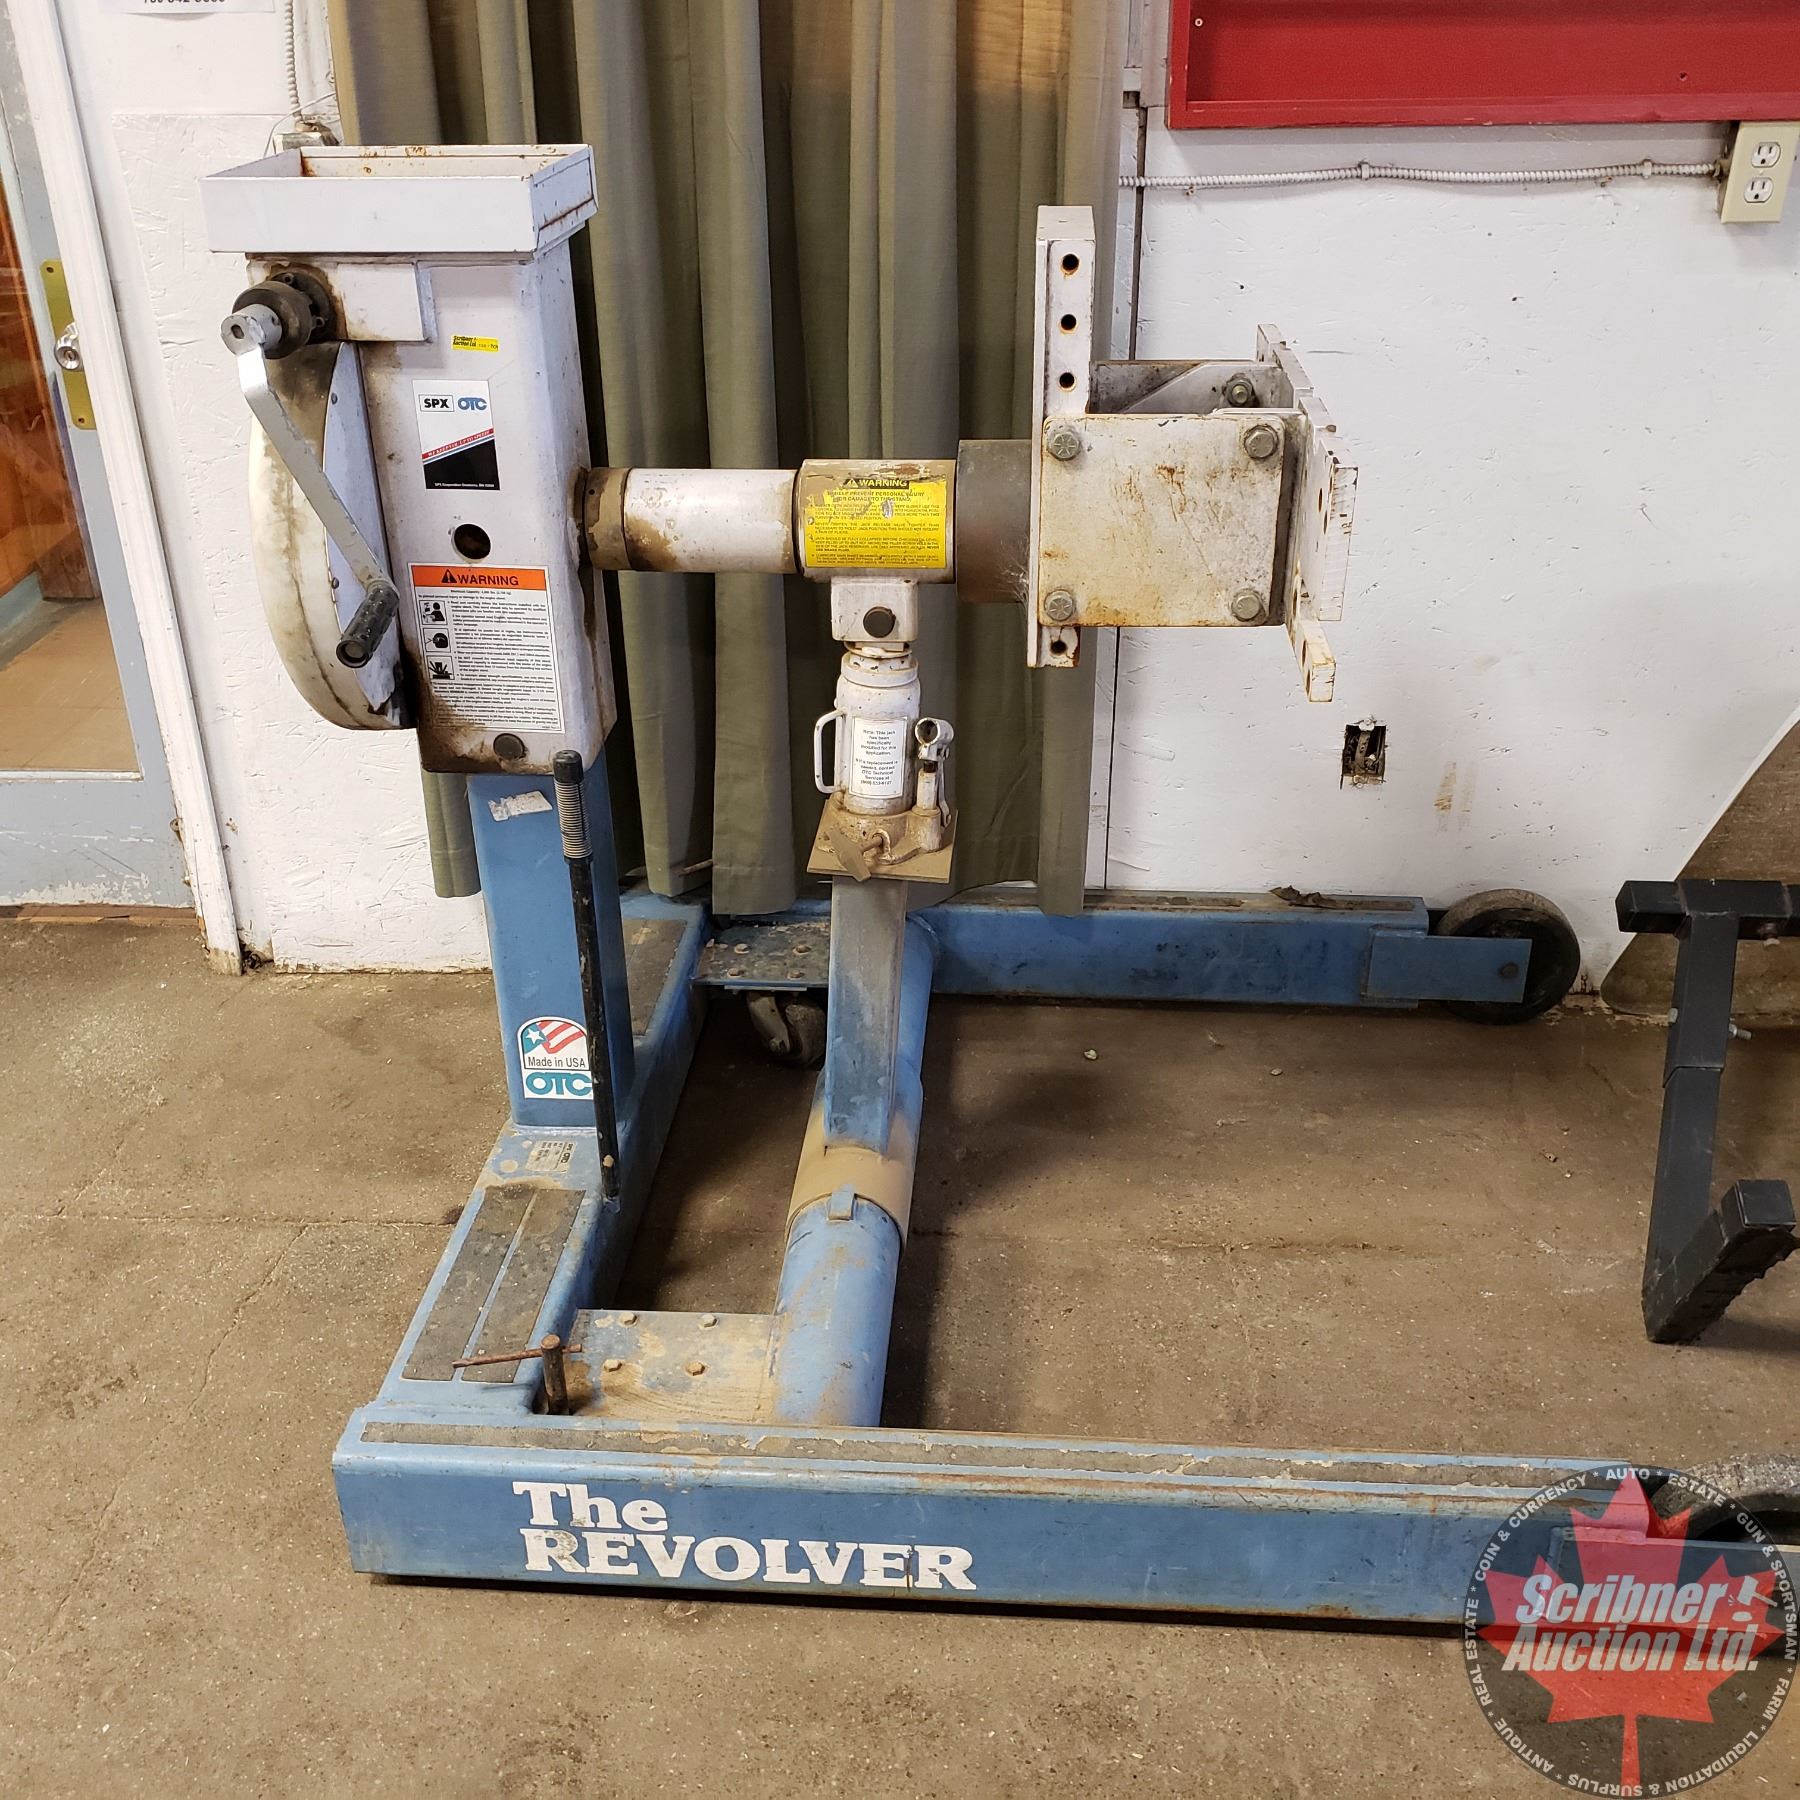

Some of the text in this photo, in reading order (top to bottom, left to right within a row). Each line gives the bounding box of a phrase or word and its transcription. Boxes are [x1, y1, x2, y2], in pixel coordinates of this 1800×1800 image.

[424, 398, 487, 410] SPX OTC
[858, 478, 908, 488] WARNING
[458, 574, 519, 586] WARNING
[528, 1056, 586, 1068] Made in USA
[526, 1072, 593, 1096] OTC
[512, 1481, 668, 1532] The
[519, 1528, 977, 1591] REVOLVER
